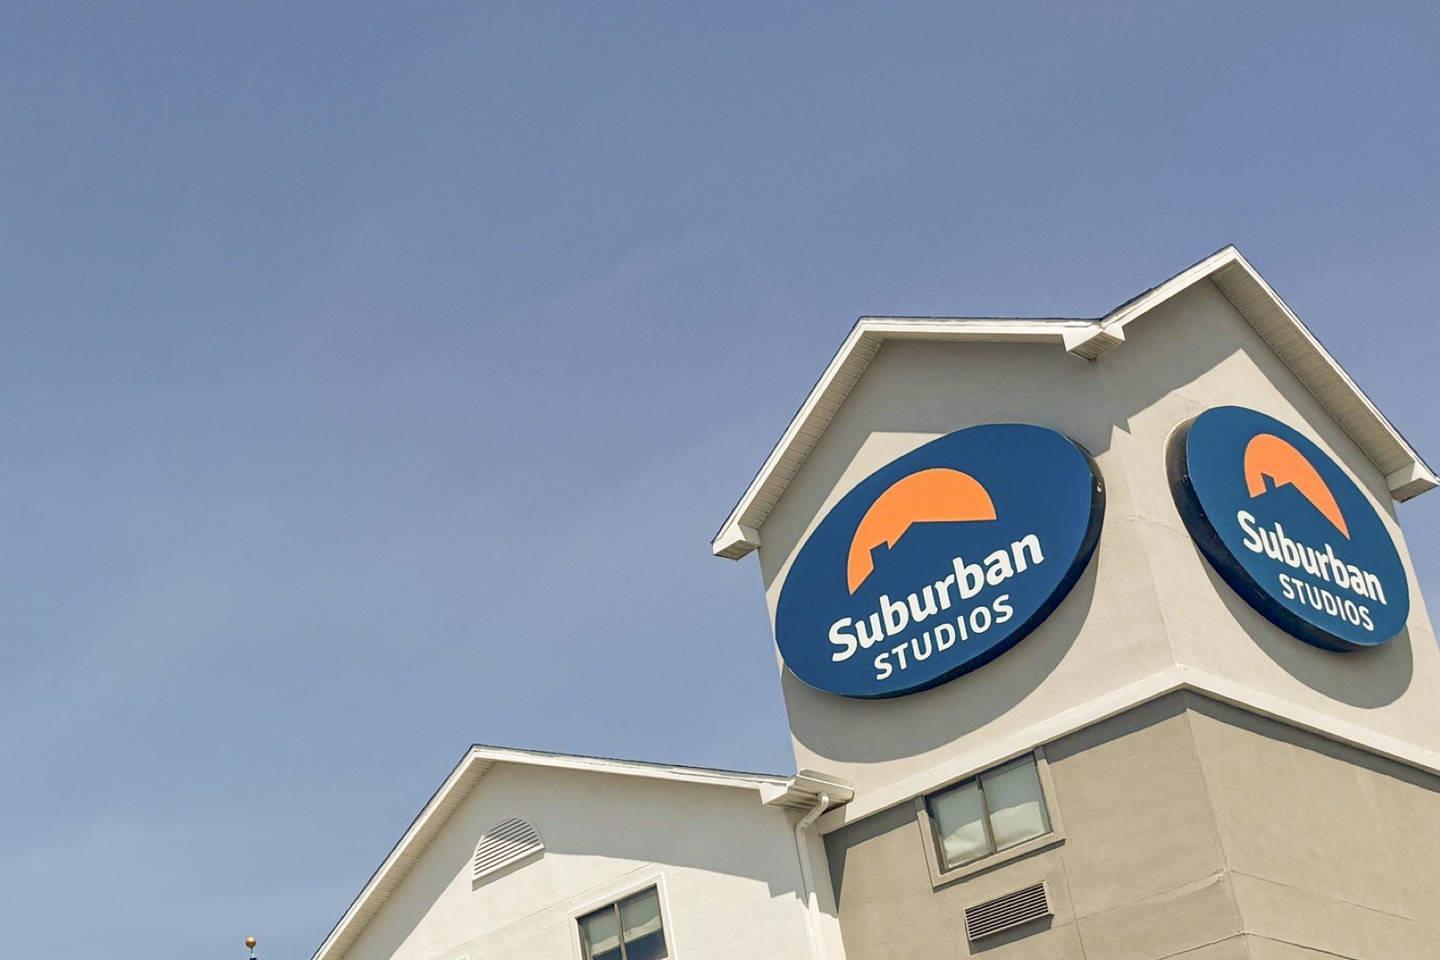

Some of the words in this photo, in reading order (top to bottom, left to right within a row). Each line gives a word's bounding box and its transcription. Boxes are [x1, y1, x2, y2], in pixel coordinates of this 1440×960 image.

[827, 533, 1045, 663] Suburban
[1237, 509, 1388, 606] Suburban
[1278, 573, 1376, 632] STUDIOS
[873, 594, 1015, 681] STUDIOS
